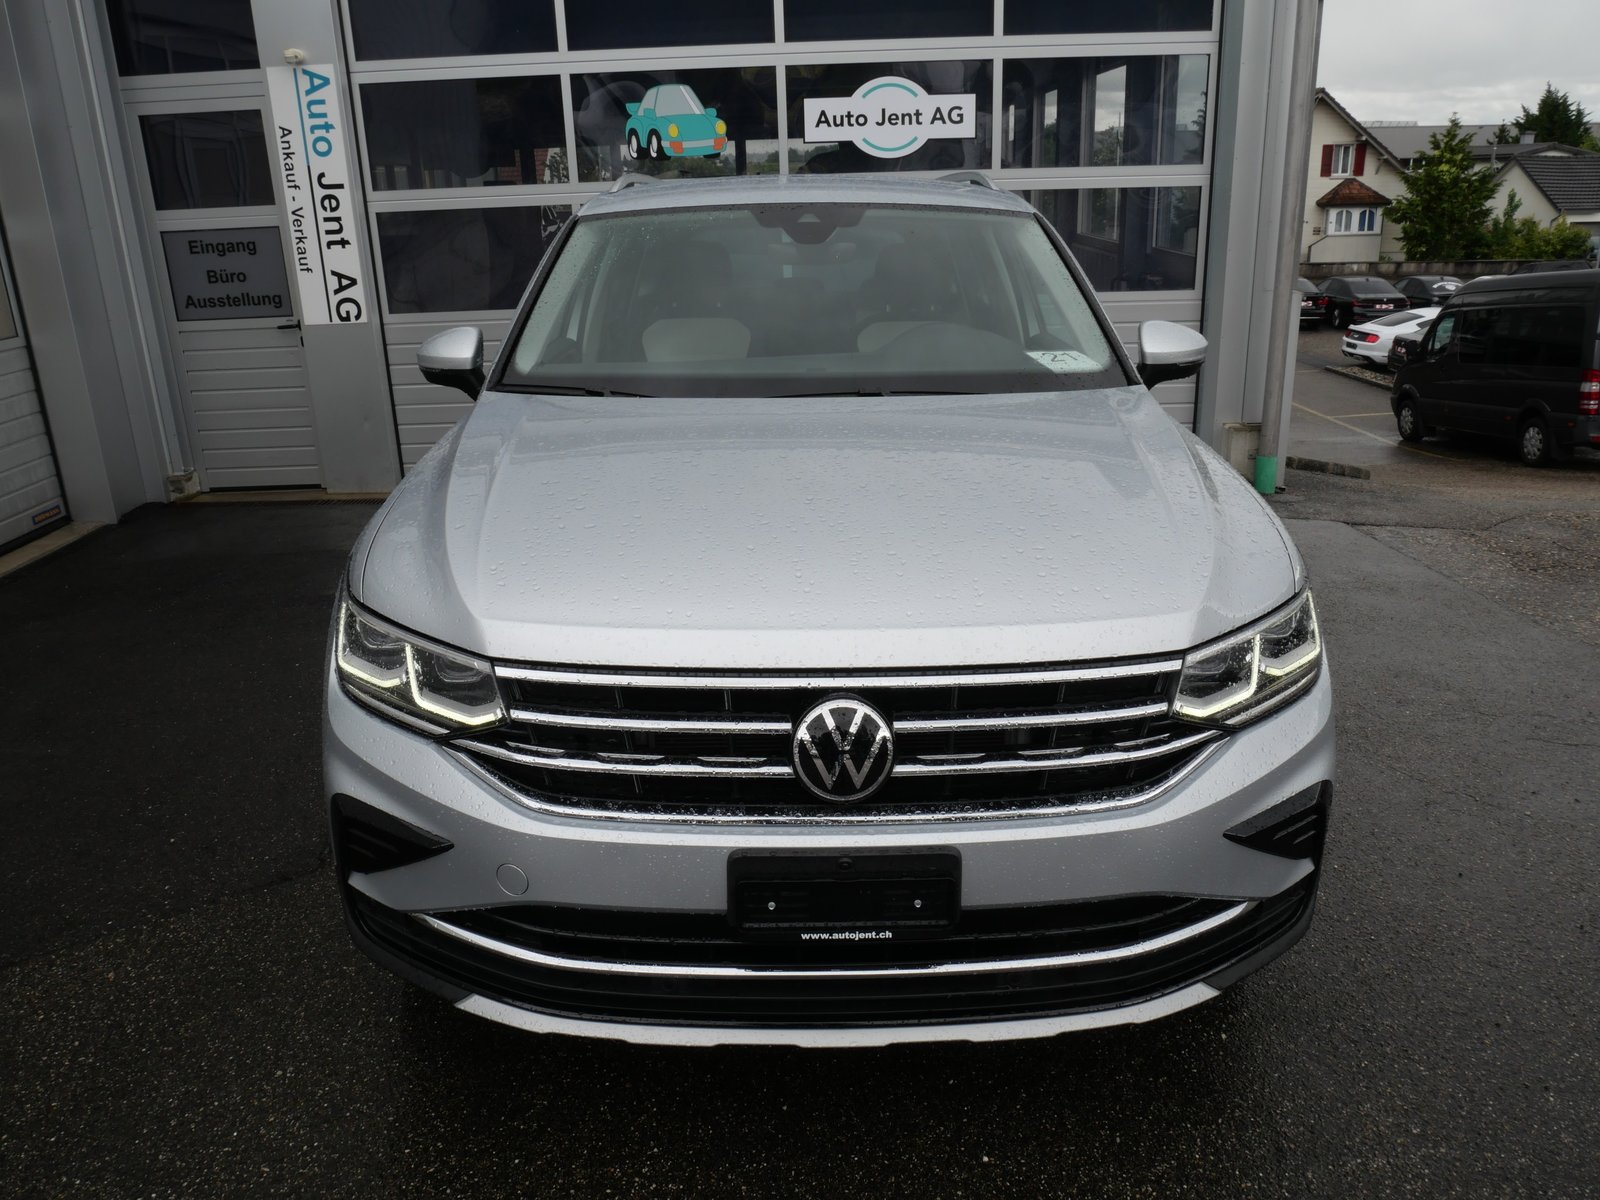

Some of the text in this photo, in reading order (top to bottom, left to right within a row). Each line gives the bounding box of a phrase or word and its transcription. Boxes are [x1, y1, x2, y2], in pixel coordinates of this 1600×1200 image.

[814, 106, 965, 128] Auto Jent AG
[278, 125, 301, 190] Ankauf
[290, 206, 313, 274] Verkauf
[301, 68, 362, 323] Auto Jent AG
[187, 239, 257, 257] Eingang
[206, 269, 247, 284] Büro
[184, 291, 283, 309] Ausstellung
[800, 930, 893, 941] www.autojent.ch
